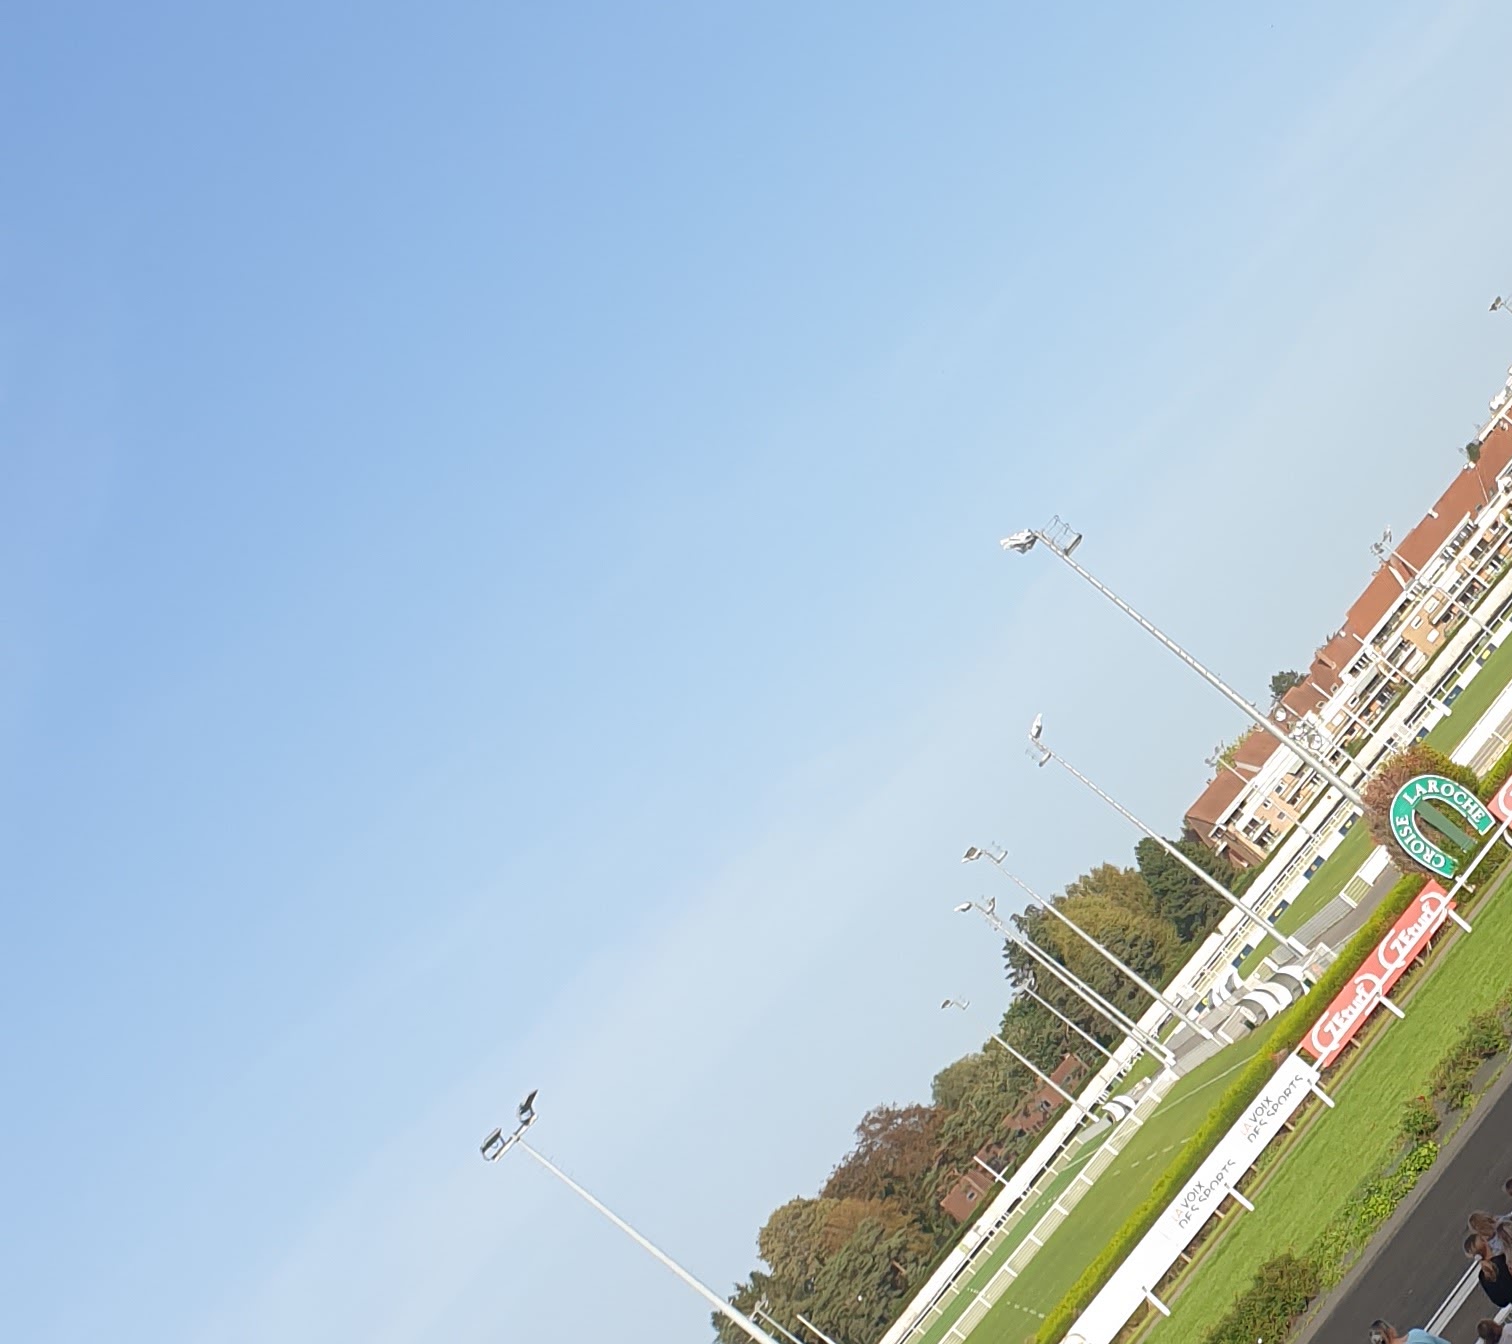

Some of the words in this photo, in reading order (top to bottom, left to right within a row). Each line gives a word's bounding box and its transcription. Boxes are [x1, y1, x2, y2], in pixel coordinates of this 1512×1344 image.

[1403, 780, 1485, 822] LAROCHE
[1396, 814, 1445, 868] CROISE
[1248, 1095, 1274, 1124] VOIX
[1179, 1180, 1205, 1209] VOIX
